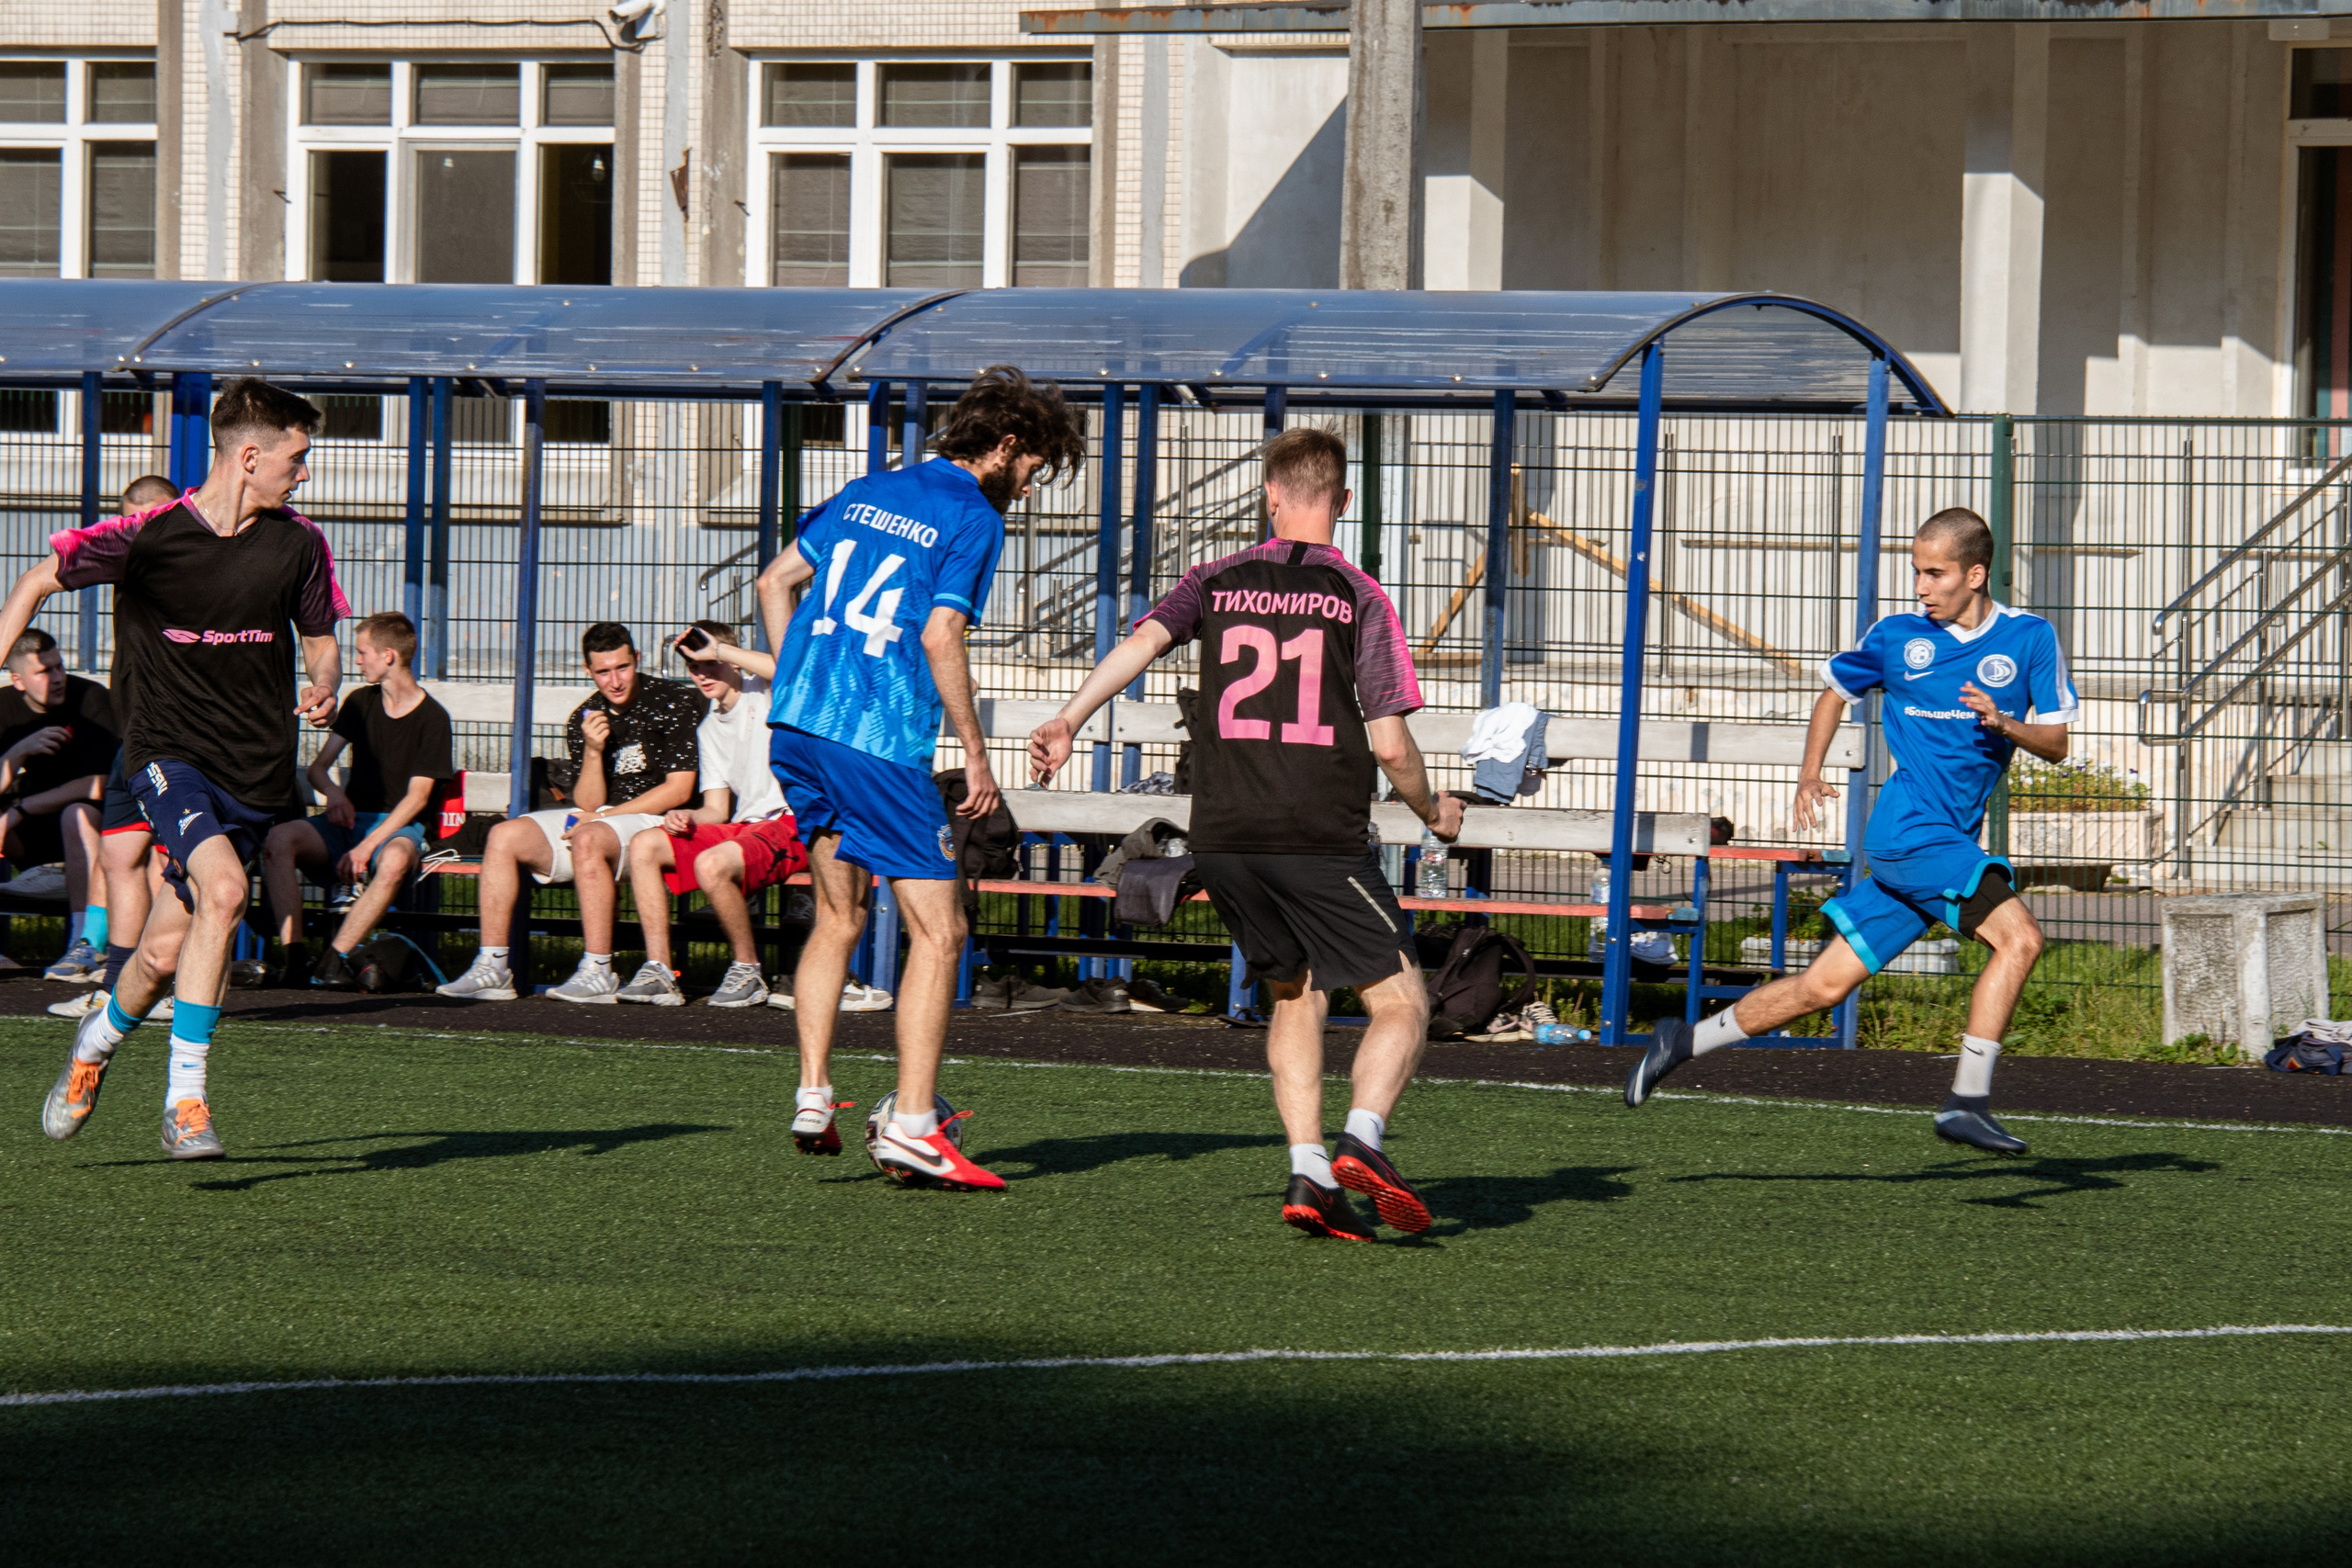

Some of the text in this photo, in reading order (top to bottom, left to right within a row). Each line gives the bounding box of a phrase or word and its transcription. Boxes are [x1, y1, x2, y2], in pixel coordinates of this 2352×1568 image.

[843, 503, 938, 548] СТЕШЕНКО
[811, 538, 907, 658] 14
[1212, 590, 1353, 624] ТИХОМИРОВ
[201, 629, 275, 645] SportTim
[1218, 625, 1334, 746] 21
